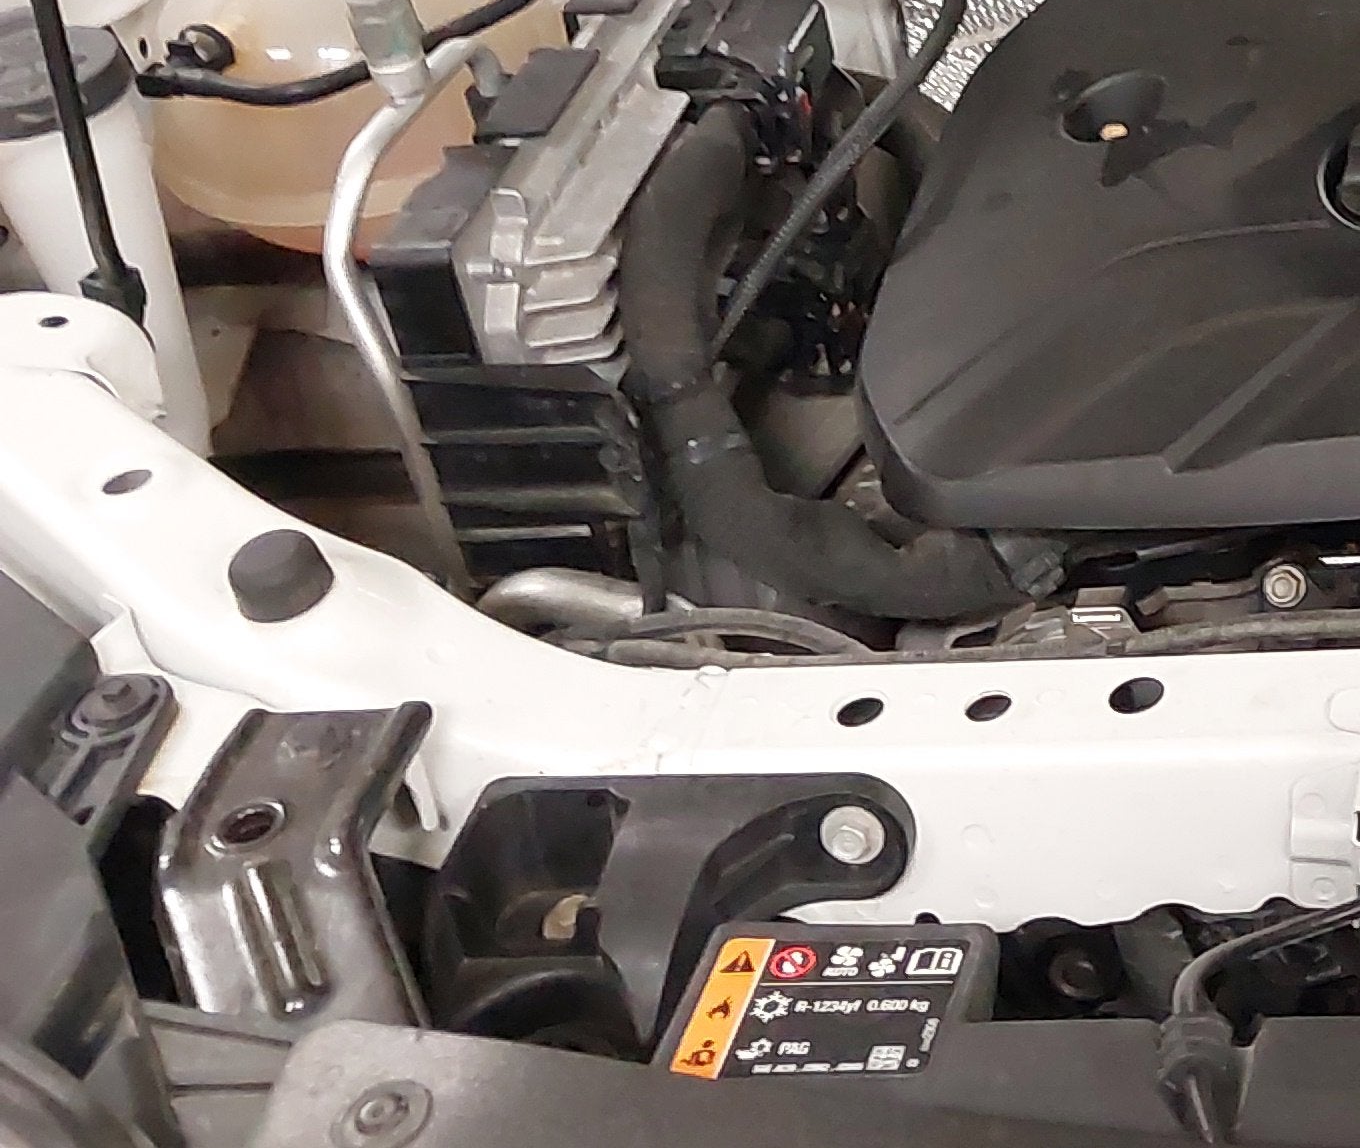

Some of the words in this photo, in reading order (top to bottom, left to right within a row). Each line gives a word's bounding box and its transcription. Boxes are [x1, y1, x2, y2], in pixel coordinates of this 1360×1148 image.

[794, 999, 862, 1014] R-1234yf
[866, 999, 909, 1011] 0.600
[909, 999, 931, 1012] kg
